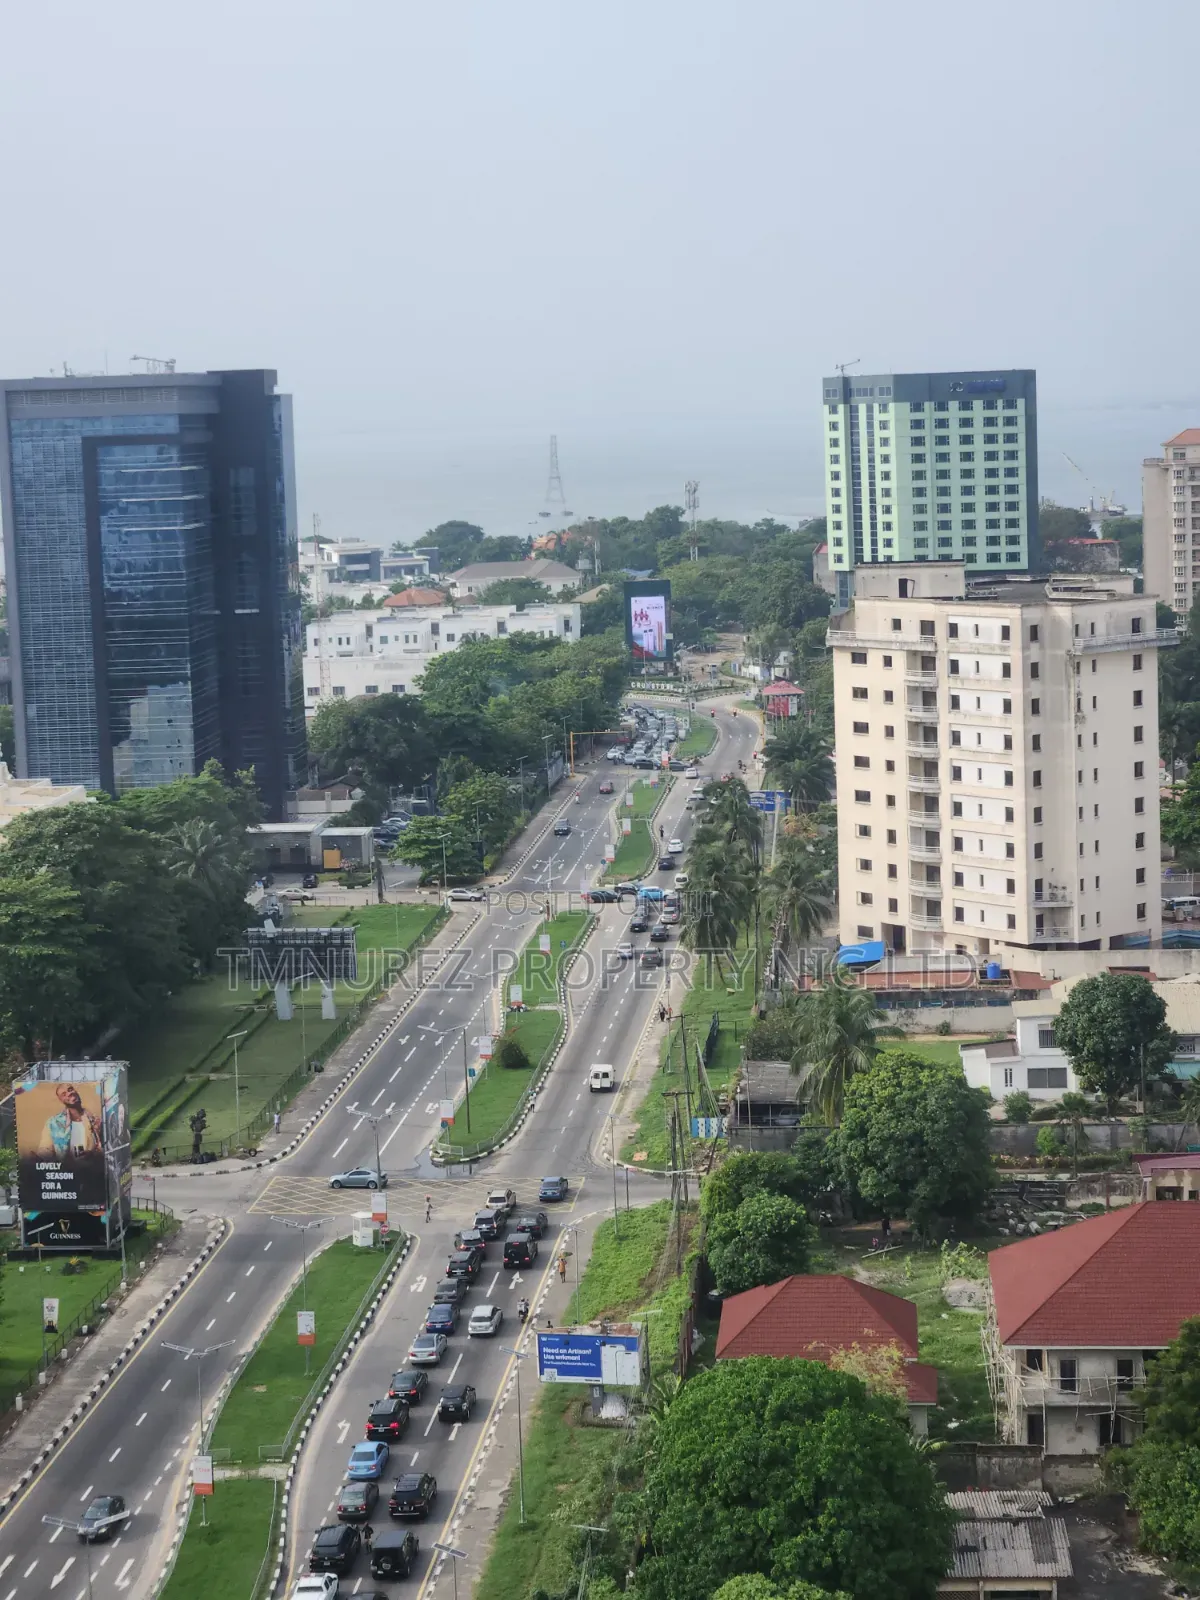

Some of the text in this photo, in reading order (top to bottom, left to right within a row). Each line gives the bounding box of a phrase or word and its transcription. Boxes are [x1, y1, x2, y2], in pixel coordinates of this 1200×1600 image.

[36, 1162, 61, 1170] LOVELY
[46, 1172, 74, 1180] SEASON
[41, 1182, 62, 1190] FOR A
[42, 1192, 77, 1200] GUINNESS
